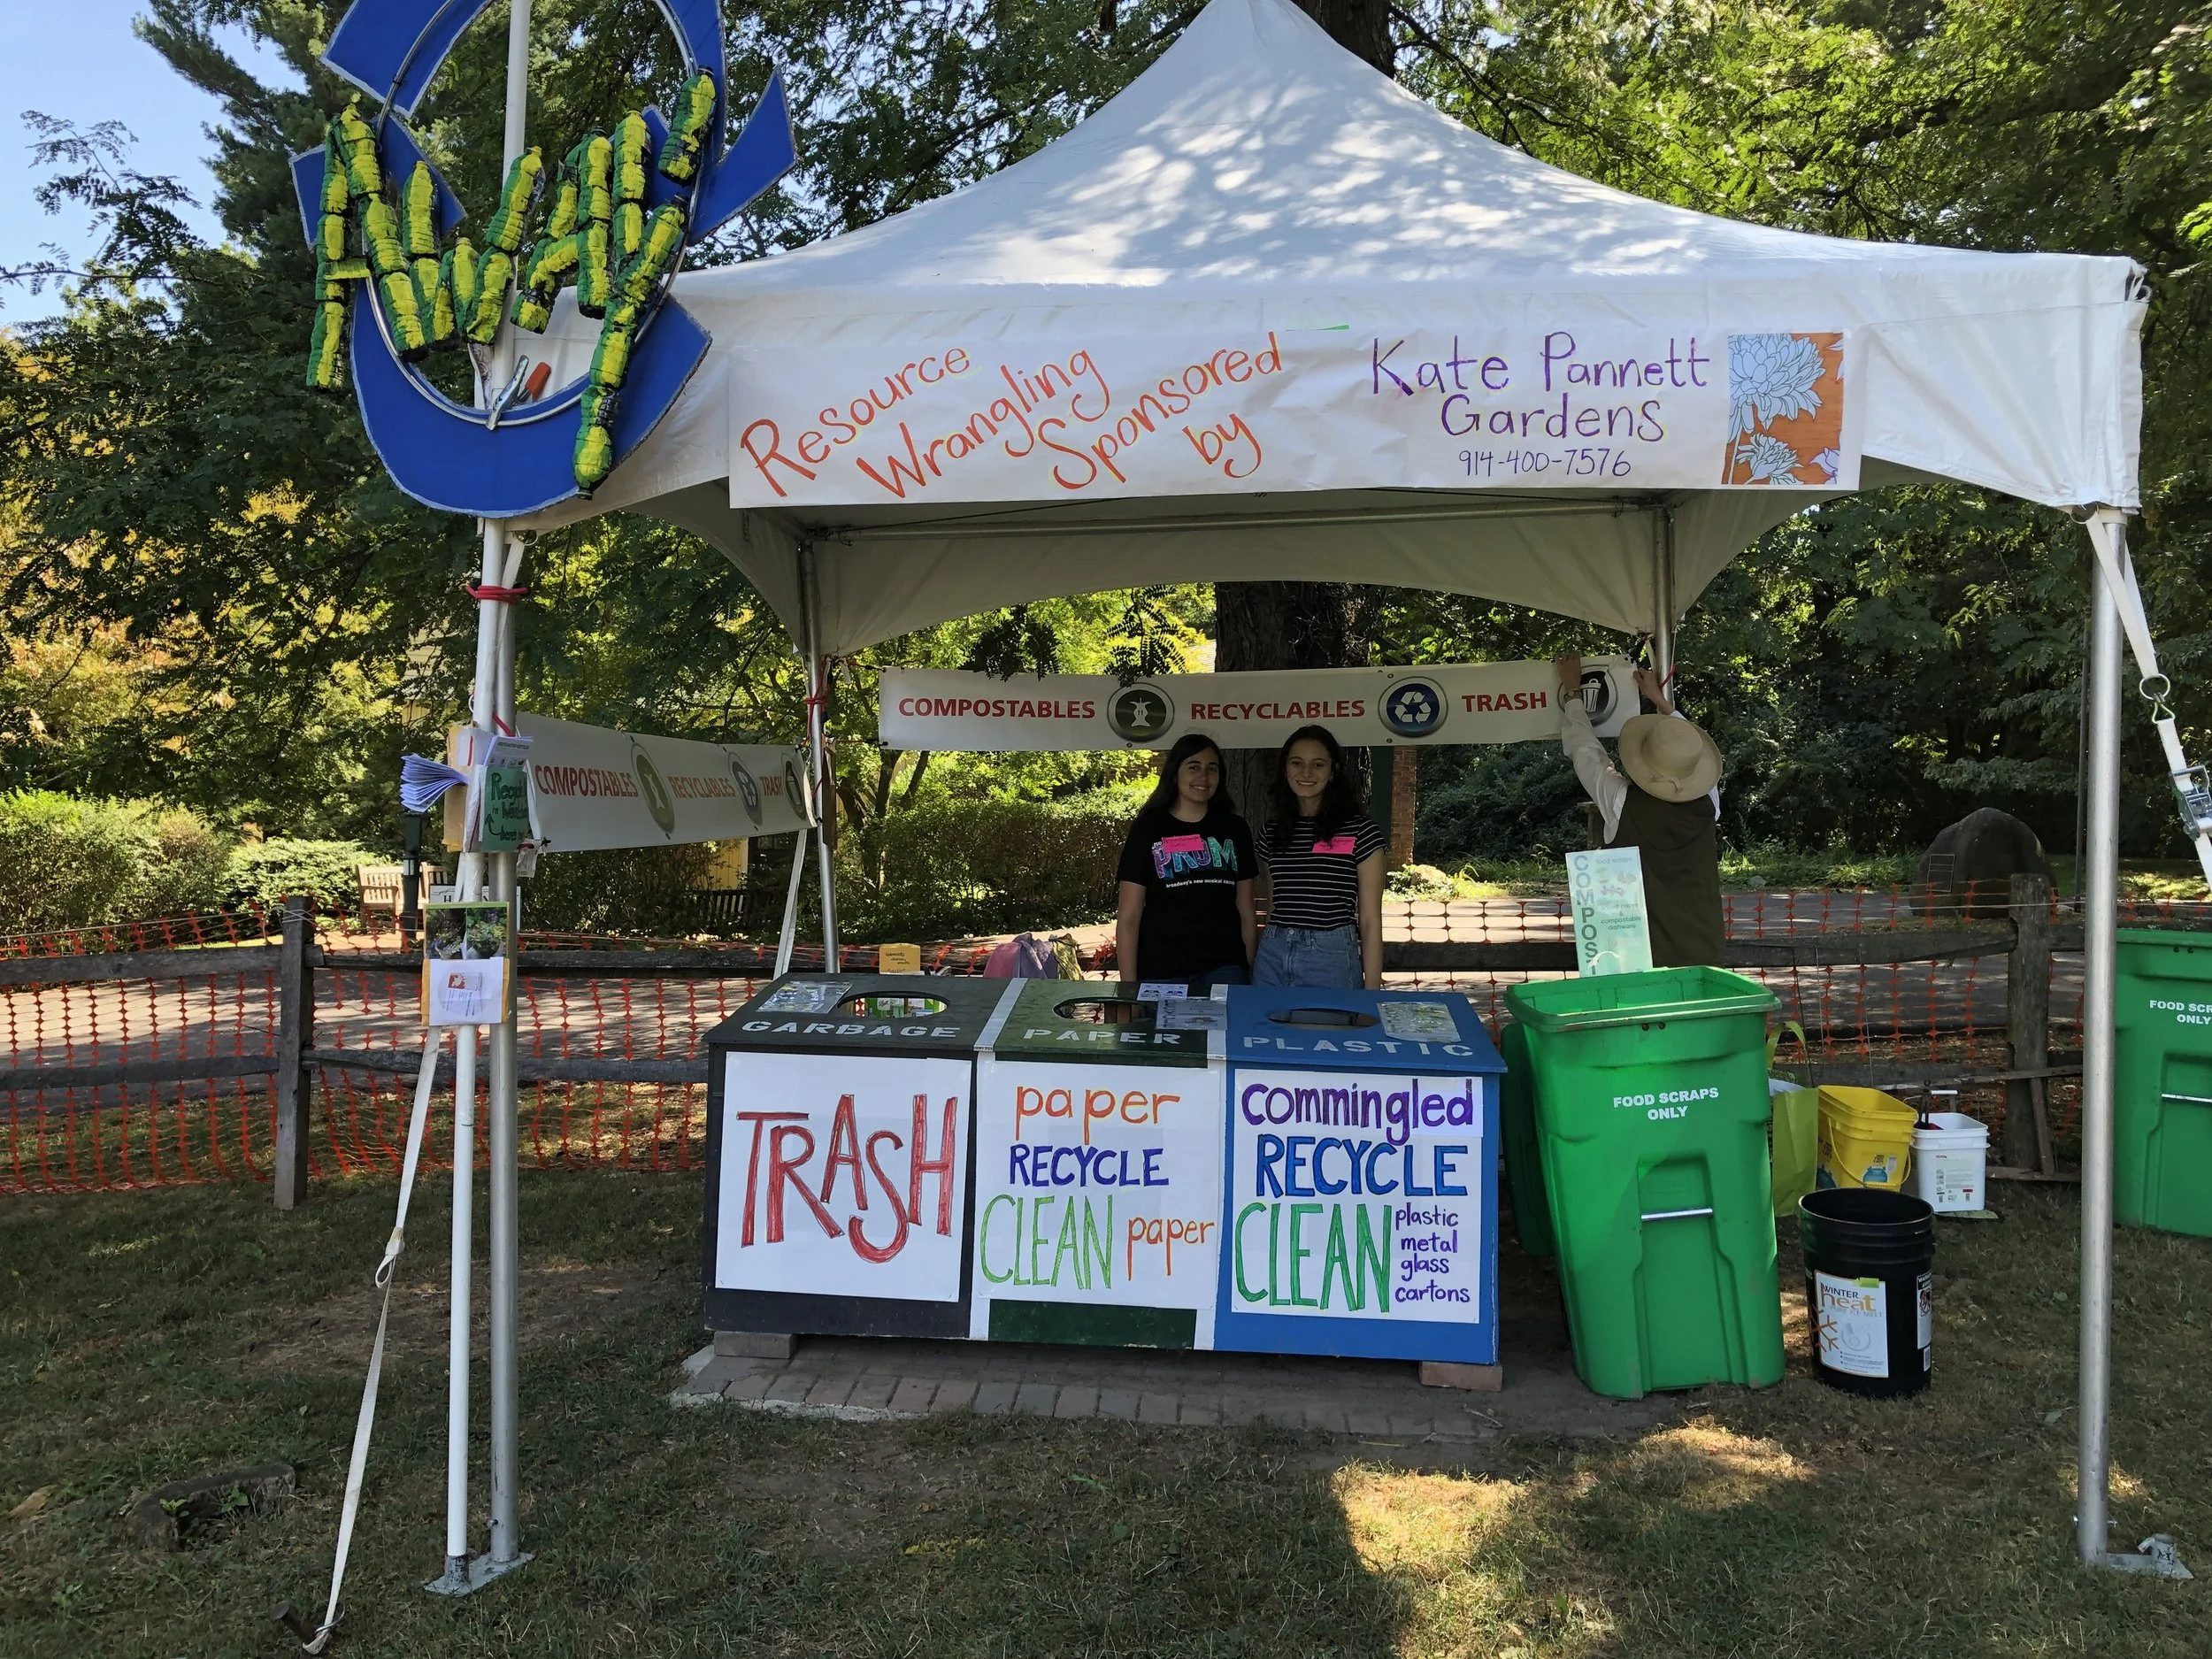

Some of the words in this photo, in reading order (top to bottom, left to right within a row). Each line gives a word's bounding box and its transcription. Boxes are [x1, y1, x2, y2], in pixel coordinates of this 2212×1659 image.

[1372, 335, 1509, 396] Kate
[1540, 331, 1710, 392] Pannett
[741, 348, 971, 497] Resource
[856, 350, 1111, 498] Wrangling
[1037, 332, 1282, 489] Sponsored
[1441, 392, 1665, 442] Gardens
[1182, 413, 1262, 479] by
[1458, 448, 1632, 477] 914-400-7576
[898, 698, 1095, 718] COMPOSTABLES
[1191, 699, 1365, 721] RECYCLABLES
[1462, 691, 1548, 712] TRASH
[534, 764, 639, 797] COMPOSTABLES
[667, 776, 736, 798] RECYCLABLES
[759, 775, 783, 796] TRASH
[1152, 836, 1239, 879] PROM
[1601, 915, 1642, 925] compostable
[2149, 1000, 2185, 1010] FOOD
[2177, 1014, 2212, 1025] ONLY
[742, 1020, 961, 1039] GARBAGE
[1023, 1029, 1182, 1045] PAPER
[1243, 1036, 1474, 1057] PLASTIC
[1613, 1094, 1655, 1108] FOOD
[1658, 1087, 1719, 1103] SCRAPS
[1015, 1086, 1180, 1144] paper
[1647, 1106, 1688, 1120] ONLY
[736, 1094, 958, 1263] TRASH
[1010, 1144, 1169, 1187] RECYCLE
[1256, 1133, 1469, 1199] RECYCLE
[1395, 1202, 1459, 1232] plastic
[980, 1194, 1113, 1290] CLEAN
[1127, 1217, 1215, 1281] paper
[1235, 1202, 1392, 1312] CLEAN
[1401, 1230, 1457, 1254] metal
[1401, 1253, 1449, 1281] glass
[1395, 1279, 1471, 1303] cartons
[1820, 1283, 1877, 1312] heat
[1824, 1285, 1859, 1299] WINTER
